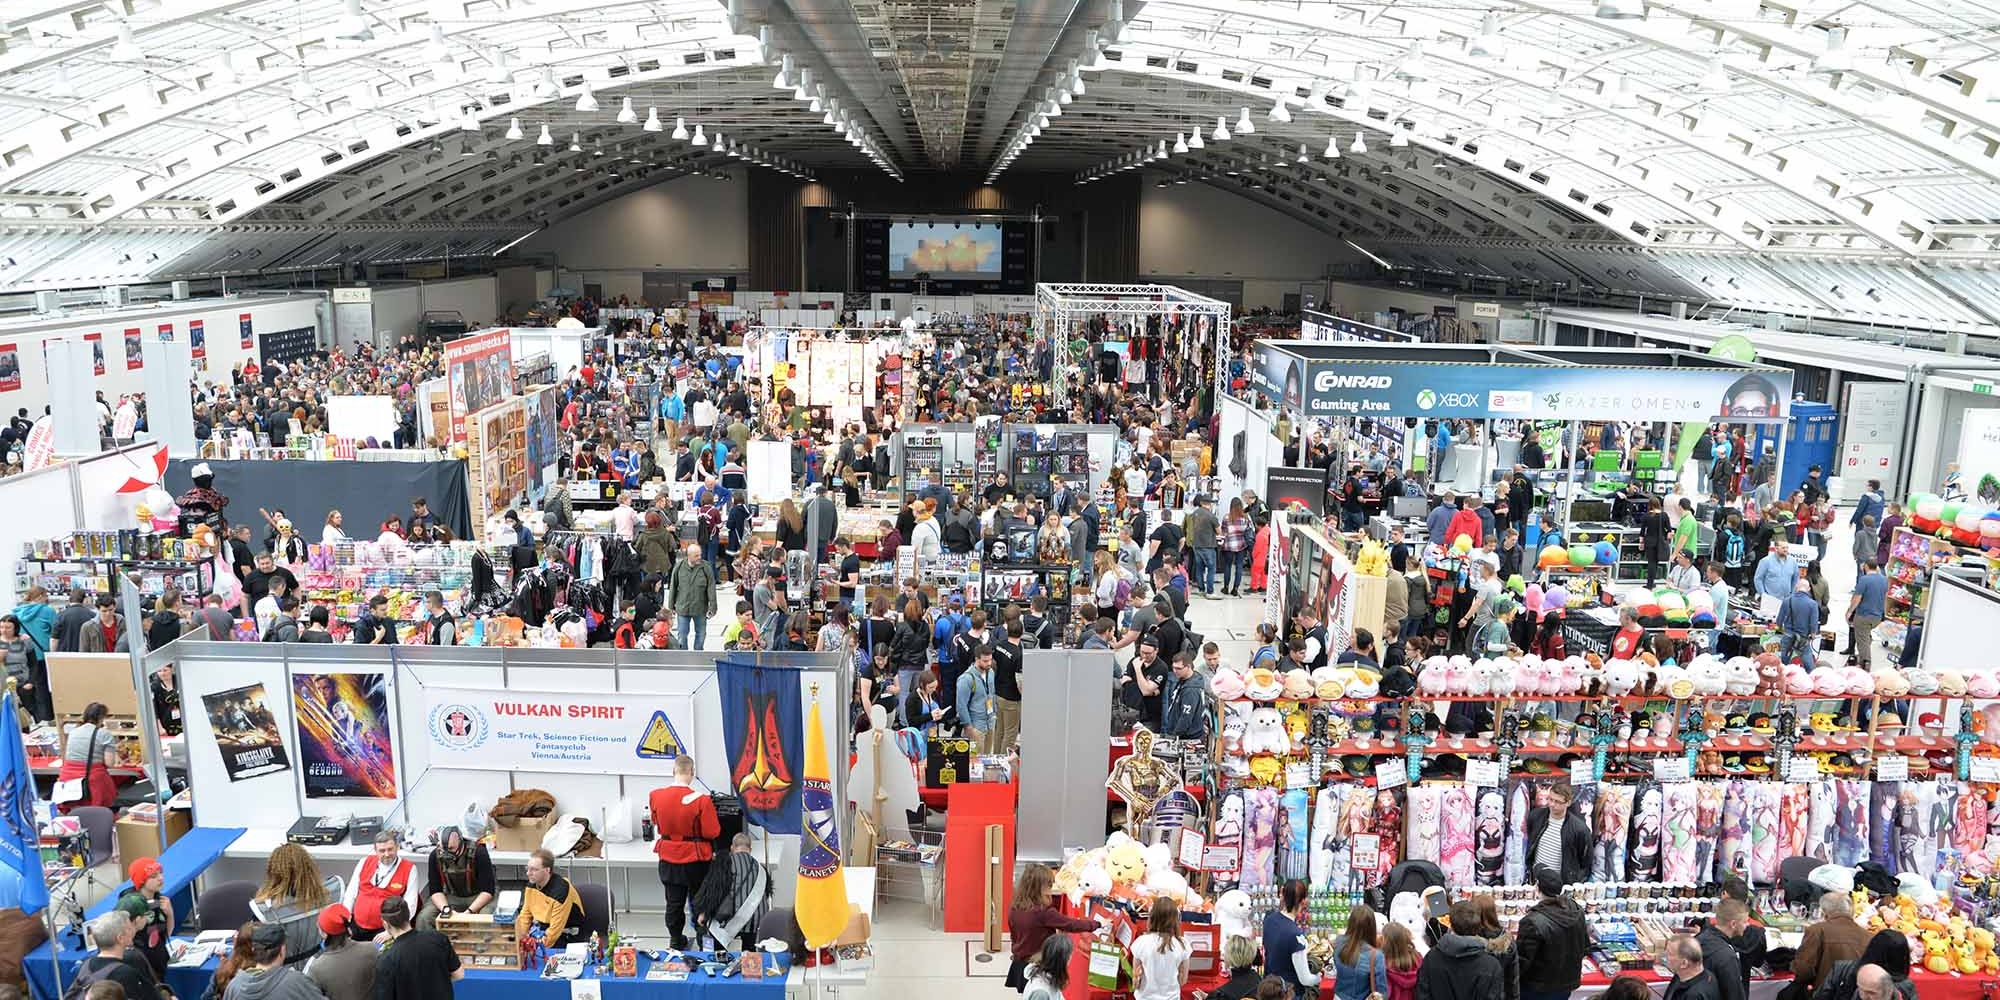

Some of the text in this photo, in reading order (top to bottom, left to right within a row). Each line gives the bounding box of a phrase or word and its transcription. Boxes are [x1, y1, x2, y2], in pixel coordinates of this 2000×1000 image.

[1314, 370, 1392, 392] CONRAD
[1311, 398, 1391, 413] Gaming Area
[1438, 392, 1479, 408] XBOX
[1565, 396, 1622, 409] RAZER
[494, 702, 625, 719] VULKAN SPIRIT
[497, 731, 517, 739] Star
[544, 733, 577, 742] Science
[611, 735, 627, 743] und
[535, 742, 587, 751] Fantasyclub
[531, 752, 592, 760] Vienna/Austria
[807, 780, 832, 792] STAR
[799, 864, 838, 878] PLANETS
